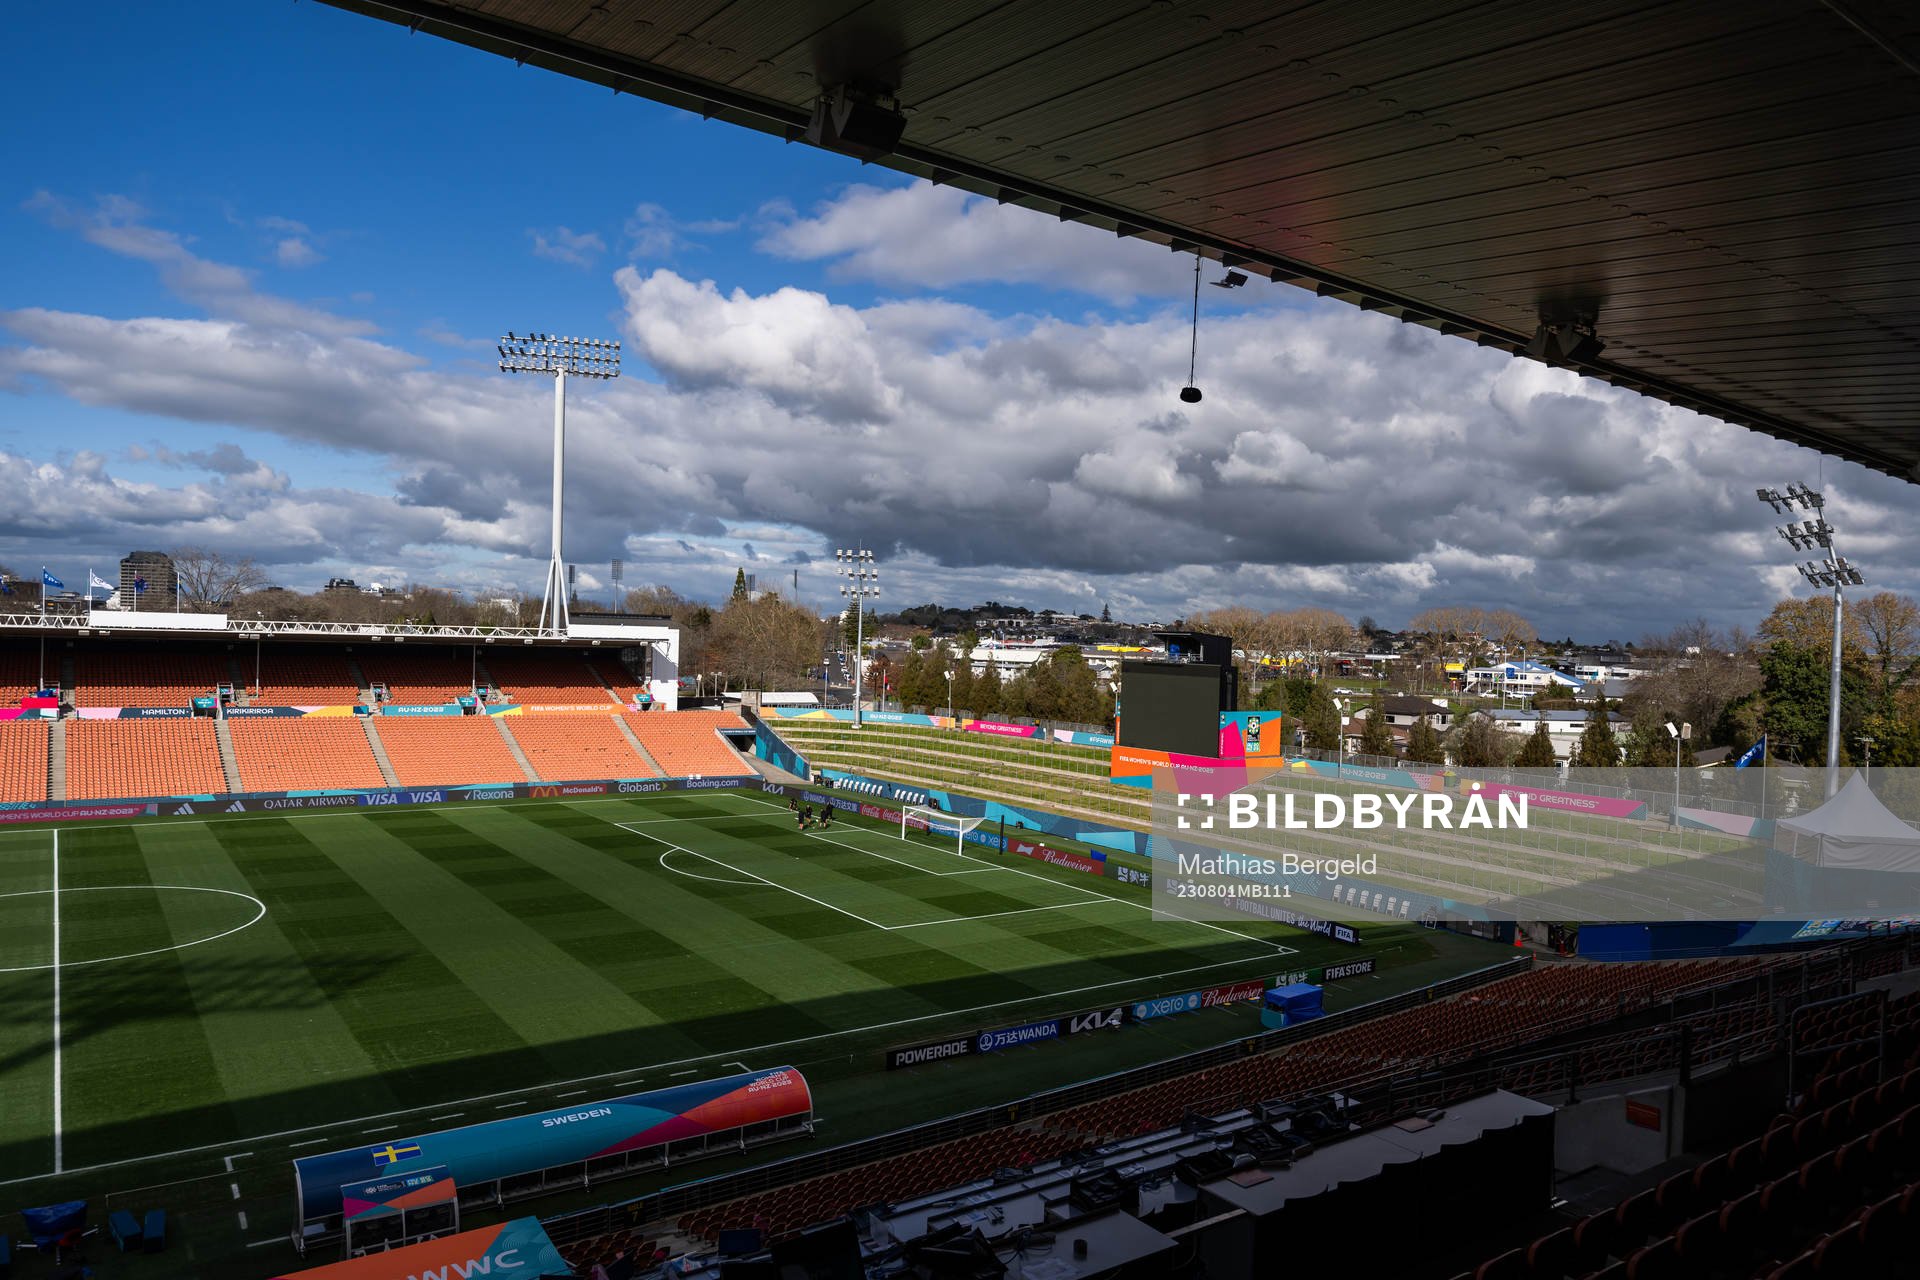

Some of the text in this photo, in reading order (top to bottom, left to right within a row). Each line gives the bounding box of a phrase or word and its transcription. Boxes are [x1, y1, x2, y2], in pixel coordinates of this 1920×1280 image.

[980, 723, 996, 731] BEYOND
[1152, 760, 1169, 768] WORLD
[618, 782, 662, 793] Globant
[686, 777, 739, 789] Booking.com
[473, 789, 514, 800] Rexona
[562, 785, 604, 794] McDonald's
[264, 796, 355, 808] QATAR AIRWAYS
[366, 793, 398, 805] VISA
[410, 791, 442, 802] VISA
[1539, 794, 1596, 808] GREATNESS
[0, 812, 29, 821] MEN'S
[31, 811, 61, 819] WORLD
[1042, 849, 1093, 873] Budweiser
[1236, 899, 1269, 917] FOOTBALL
[1270, 908, 1295, 924] UNITES
[1337, 929, 1351, 939] FIFA
[1202, 985, 1264, 1008] Budweiser
[1151, 997, 1184, 1016] xero
[1018, 1023, 1057, 1041] WANDA
[895, 1040, 968, 1066] POWERADE
[542, 1107, 612, 1128] SWEDEN
